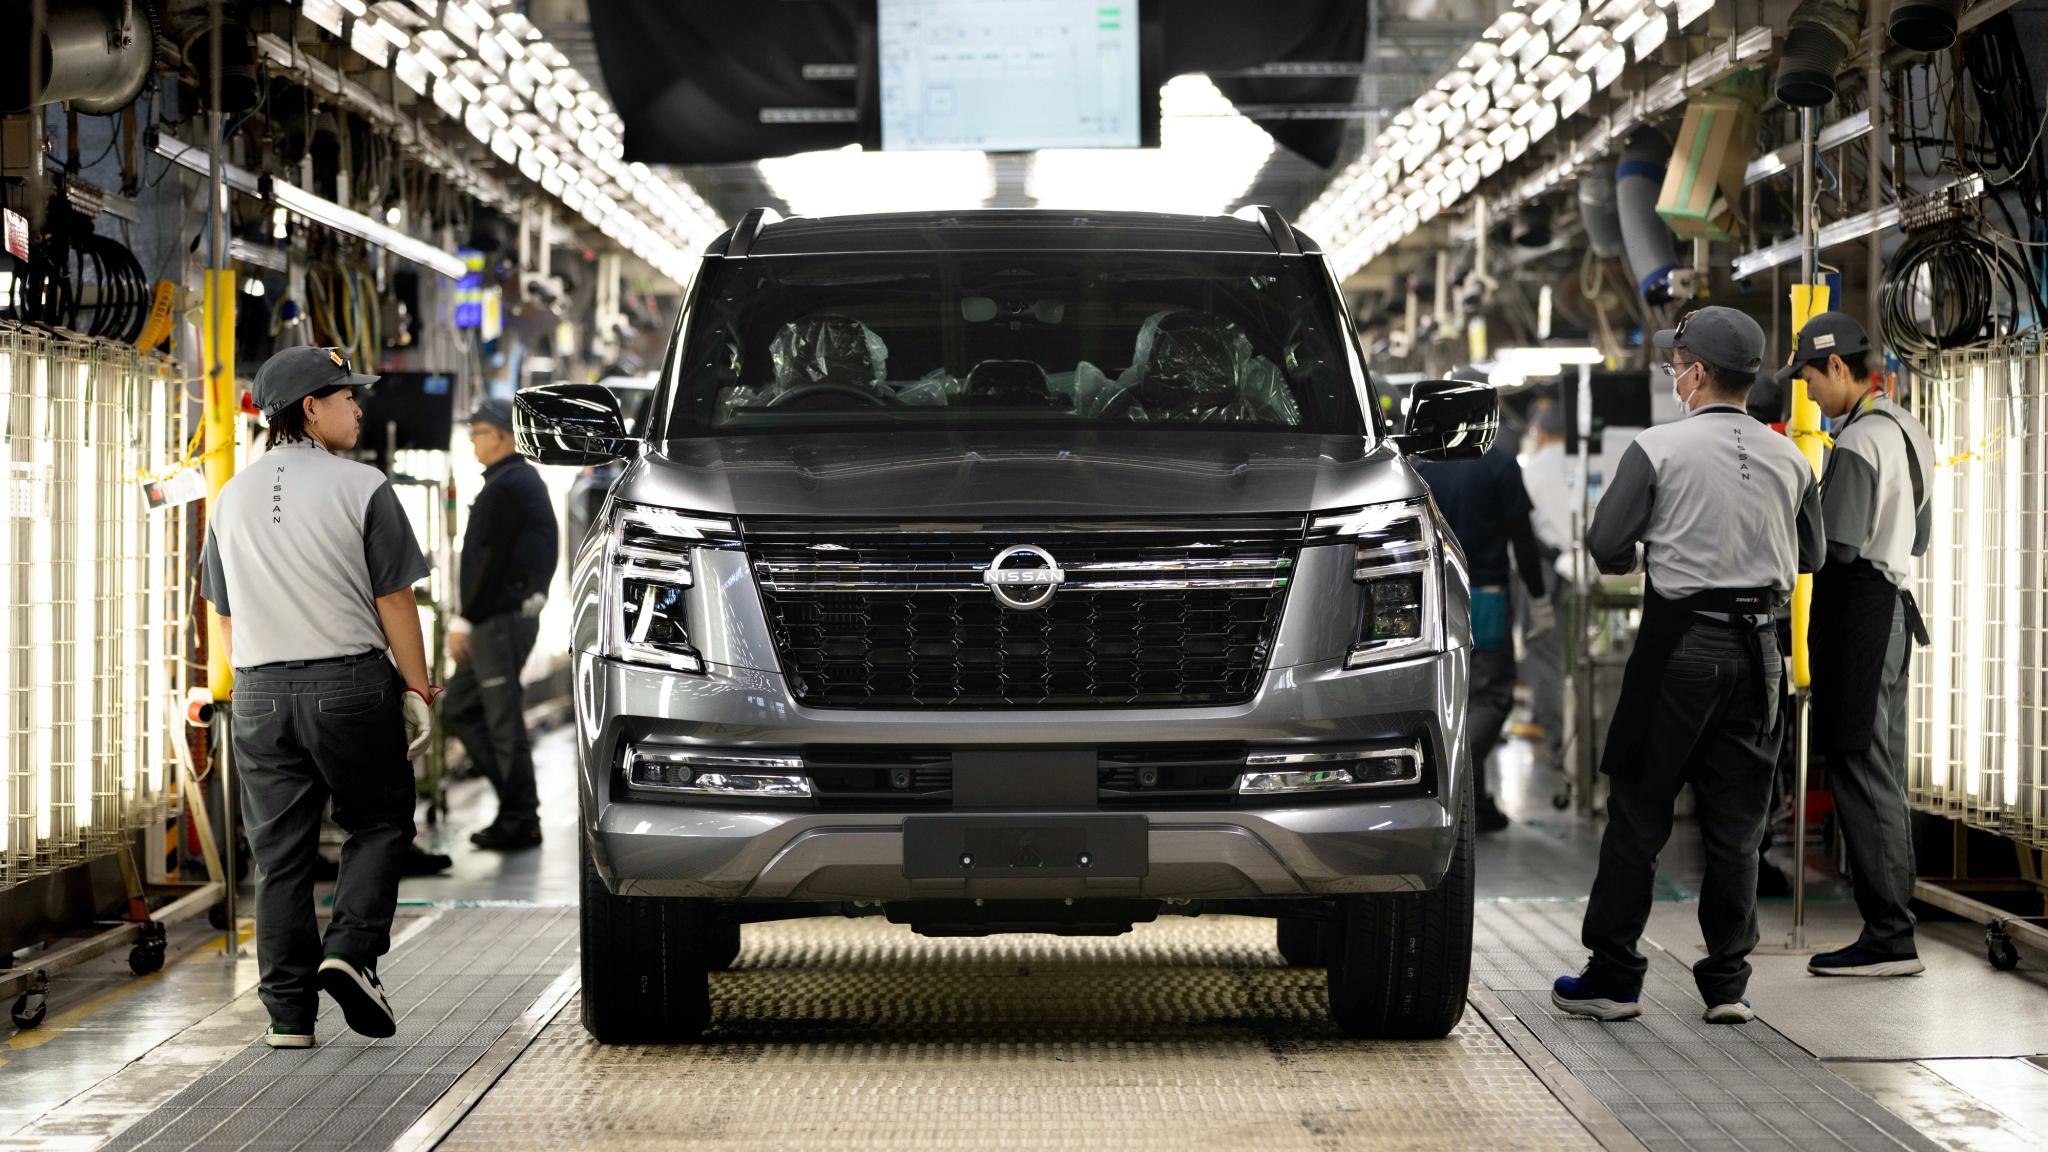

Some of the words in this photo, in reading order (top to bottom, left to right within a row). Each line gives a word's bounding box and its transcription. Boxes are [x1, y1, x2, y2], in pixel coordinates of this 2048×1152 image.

[1733, 428, 1750, 480] NISSAN
[272, 466, 285, 524] NISSAN
[986, 571, 1063, 582] NISSAN
